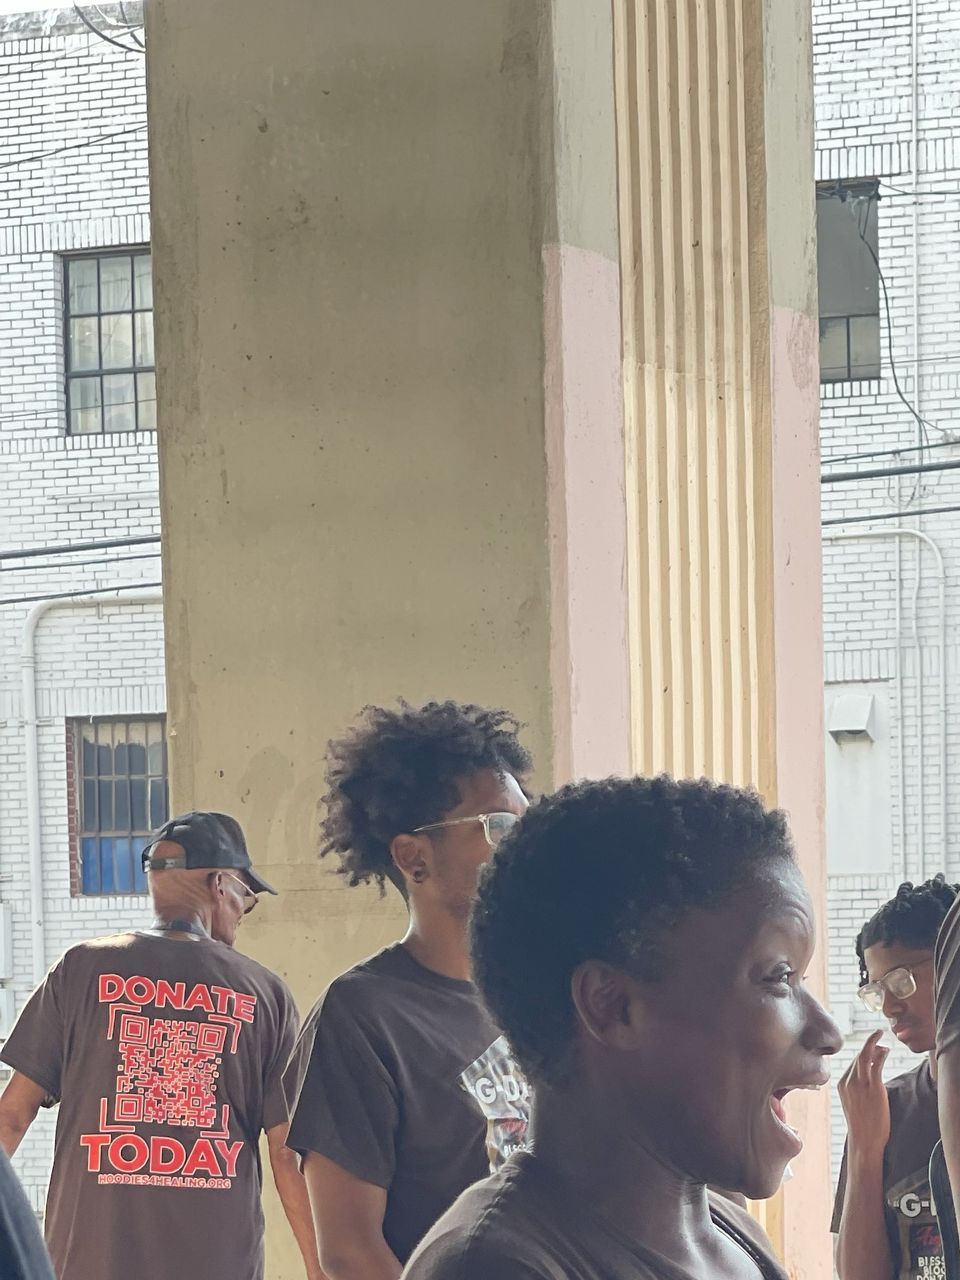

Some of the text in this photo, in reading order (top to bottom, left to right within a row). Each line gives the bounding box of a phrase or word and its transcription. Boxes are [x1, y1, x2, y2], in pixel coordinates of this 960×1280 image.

[98, 973, 257, 1023] DONATE
[80, 1134, 245, 1177] TODAY
[97, 1174, 232, 1190] HOODIES4HEALING.ORG
